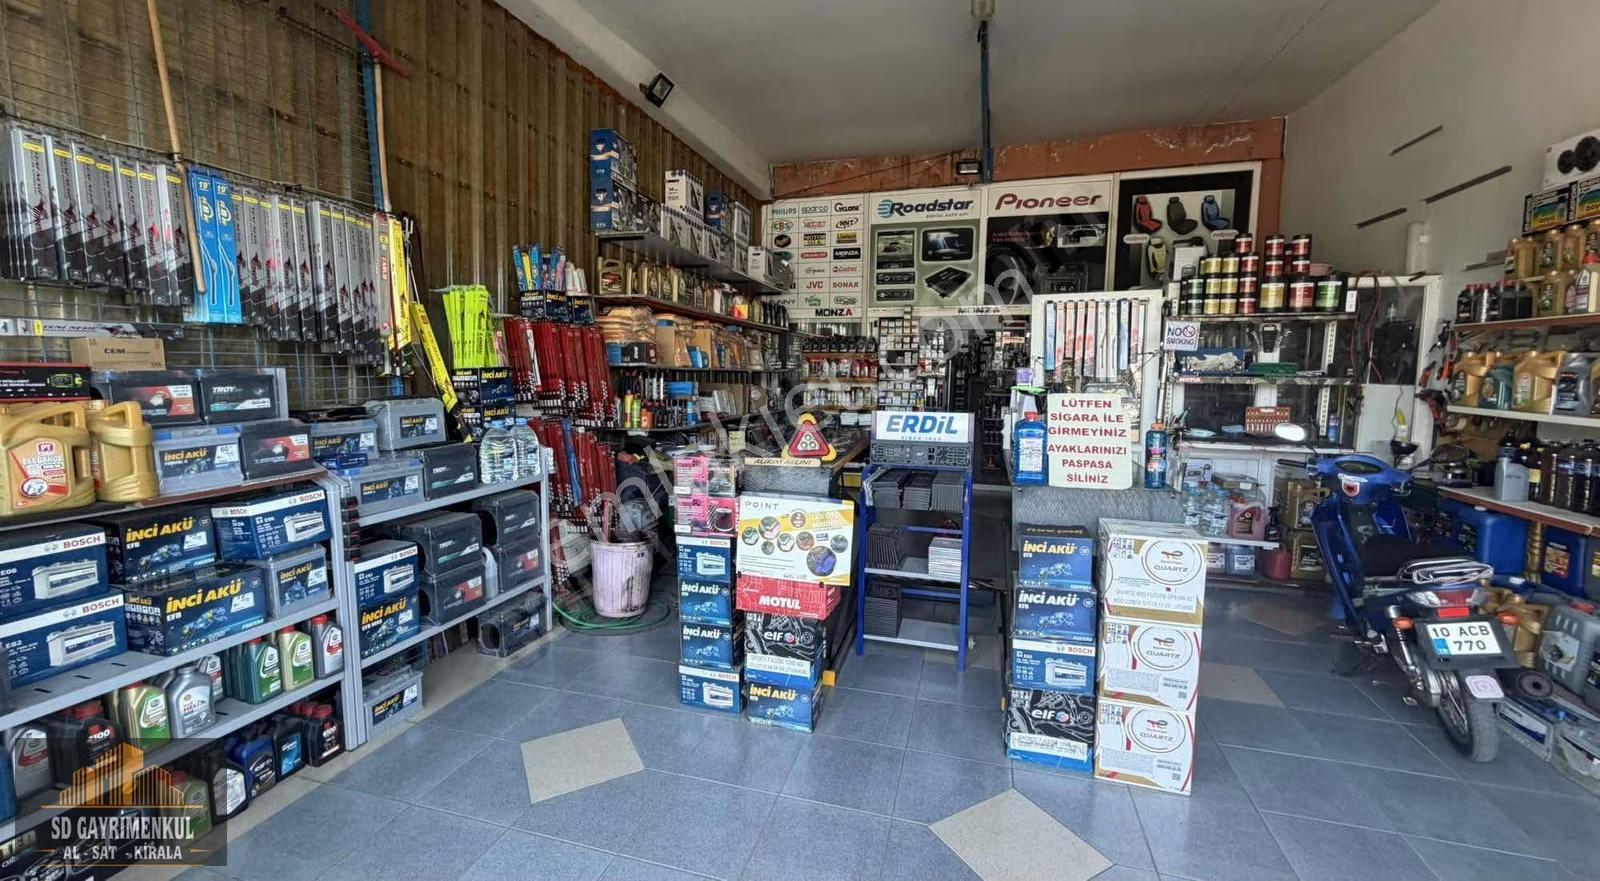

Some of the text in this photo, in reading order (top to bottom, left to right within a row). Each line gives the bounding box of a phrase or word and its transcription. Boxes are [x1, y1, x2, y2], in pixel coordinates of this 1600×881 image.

[890, 198, 974, 216] Roadstar
[995, 193, 1103, 211] Pioneer
[806, 281, 824, 289] JVC
[815, 309, 853, 317] MONZA
[1167, 327, 1182, 337] NO
[1166, 338, 1195, 346] SMOKING
[211, 386, 237, 394] TROY
[1061, 398, 1112, 409] LÜTFEN
[1050, 412, 1124, 423] SİGARA İLE
[1048, 426, 1127, 438] GİRMEYİNİZ
[1048, 445, 1127, 455] AYAKLARINIZI
[1061, 459, 1113, 469] PASPASA
[1066, 472, 1109, 484] SİLİNİZ
[299, 492, 323, 503] BOSCH
[744, 501, 779, 511] POINT
[126, 516, 194, 543] İNCİ AKÜ
[63, 535, 101, 549] BOSCH
[1023, 540, 1076, 555] İNCİ AKÜ
[1153, 564, 1189, 574] QUARTZ
[700, 583, 720, 595] AKÜ
[166, 578, 242, 613] İNCİ AKÜ
[1018, 590, 1077, 607] İNCİ AKÜ
[82, 598, 121, 613] BOSCH
[759, 595, 801, 610] MOTUL
[362, 596, 407, 625] İNCİ AKÜ
[700, 626, 721, 639] AKÜ
[764, 631, 783, 642] elf
[1432, 625, 1490, 638] 10 ACB
[1067, 646, 1094, 654] BOSCH
[1453, 640, 1487, 652] 770
[1145, 650, 1181, 659] QUARTZ
[750, 684, 797, 701] İNCİ AKÜ
[1032, 709, 1055, 720] elf
